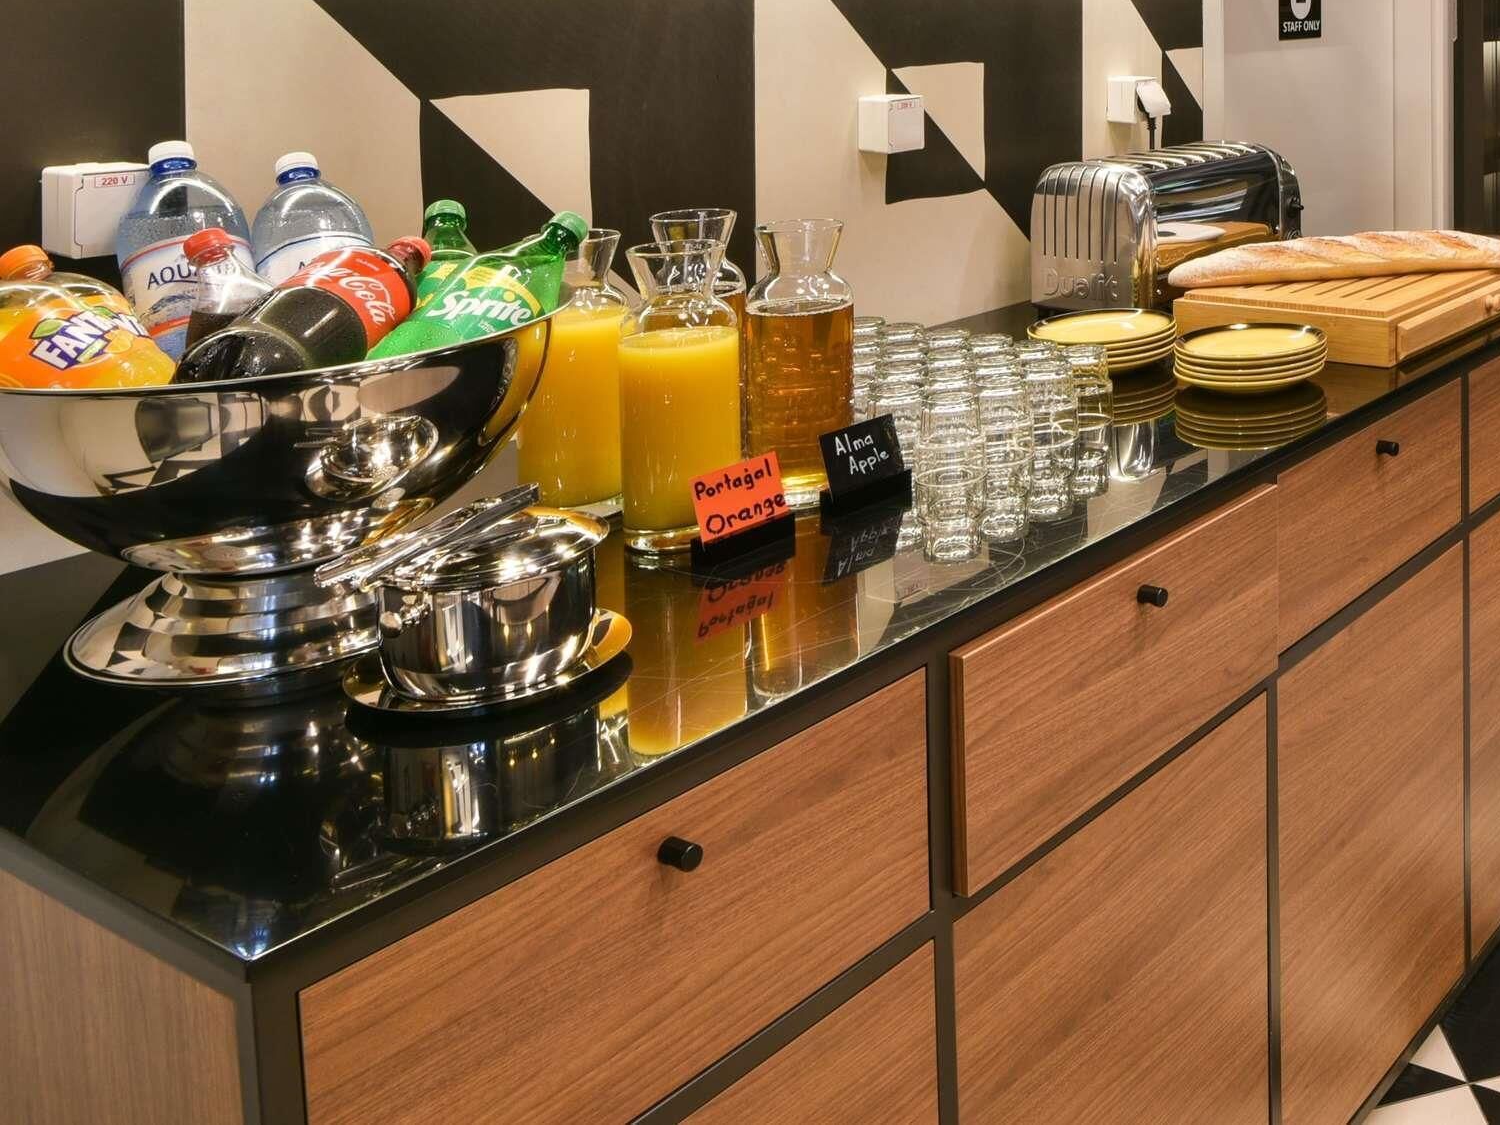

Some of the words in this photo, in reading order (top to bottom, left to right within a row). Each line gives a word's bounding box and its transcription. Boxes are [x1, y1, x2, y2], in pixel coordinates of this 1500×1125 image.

[1283, 21, 1303, 33] STAFF
[1303, 20, 1320, 32] ONLY
[102, 177, 119, 186] 220
[122, 175, 128, 184] V
[1040, 266, 1118, 301] Dualit
[426, 290, 531, 325] Sprite
[835, 433, 874, 456] Alma
[849, 447, 889, 475] Apple
[705, 493, 787, 535] Orange
